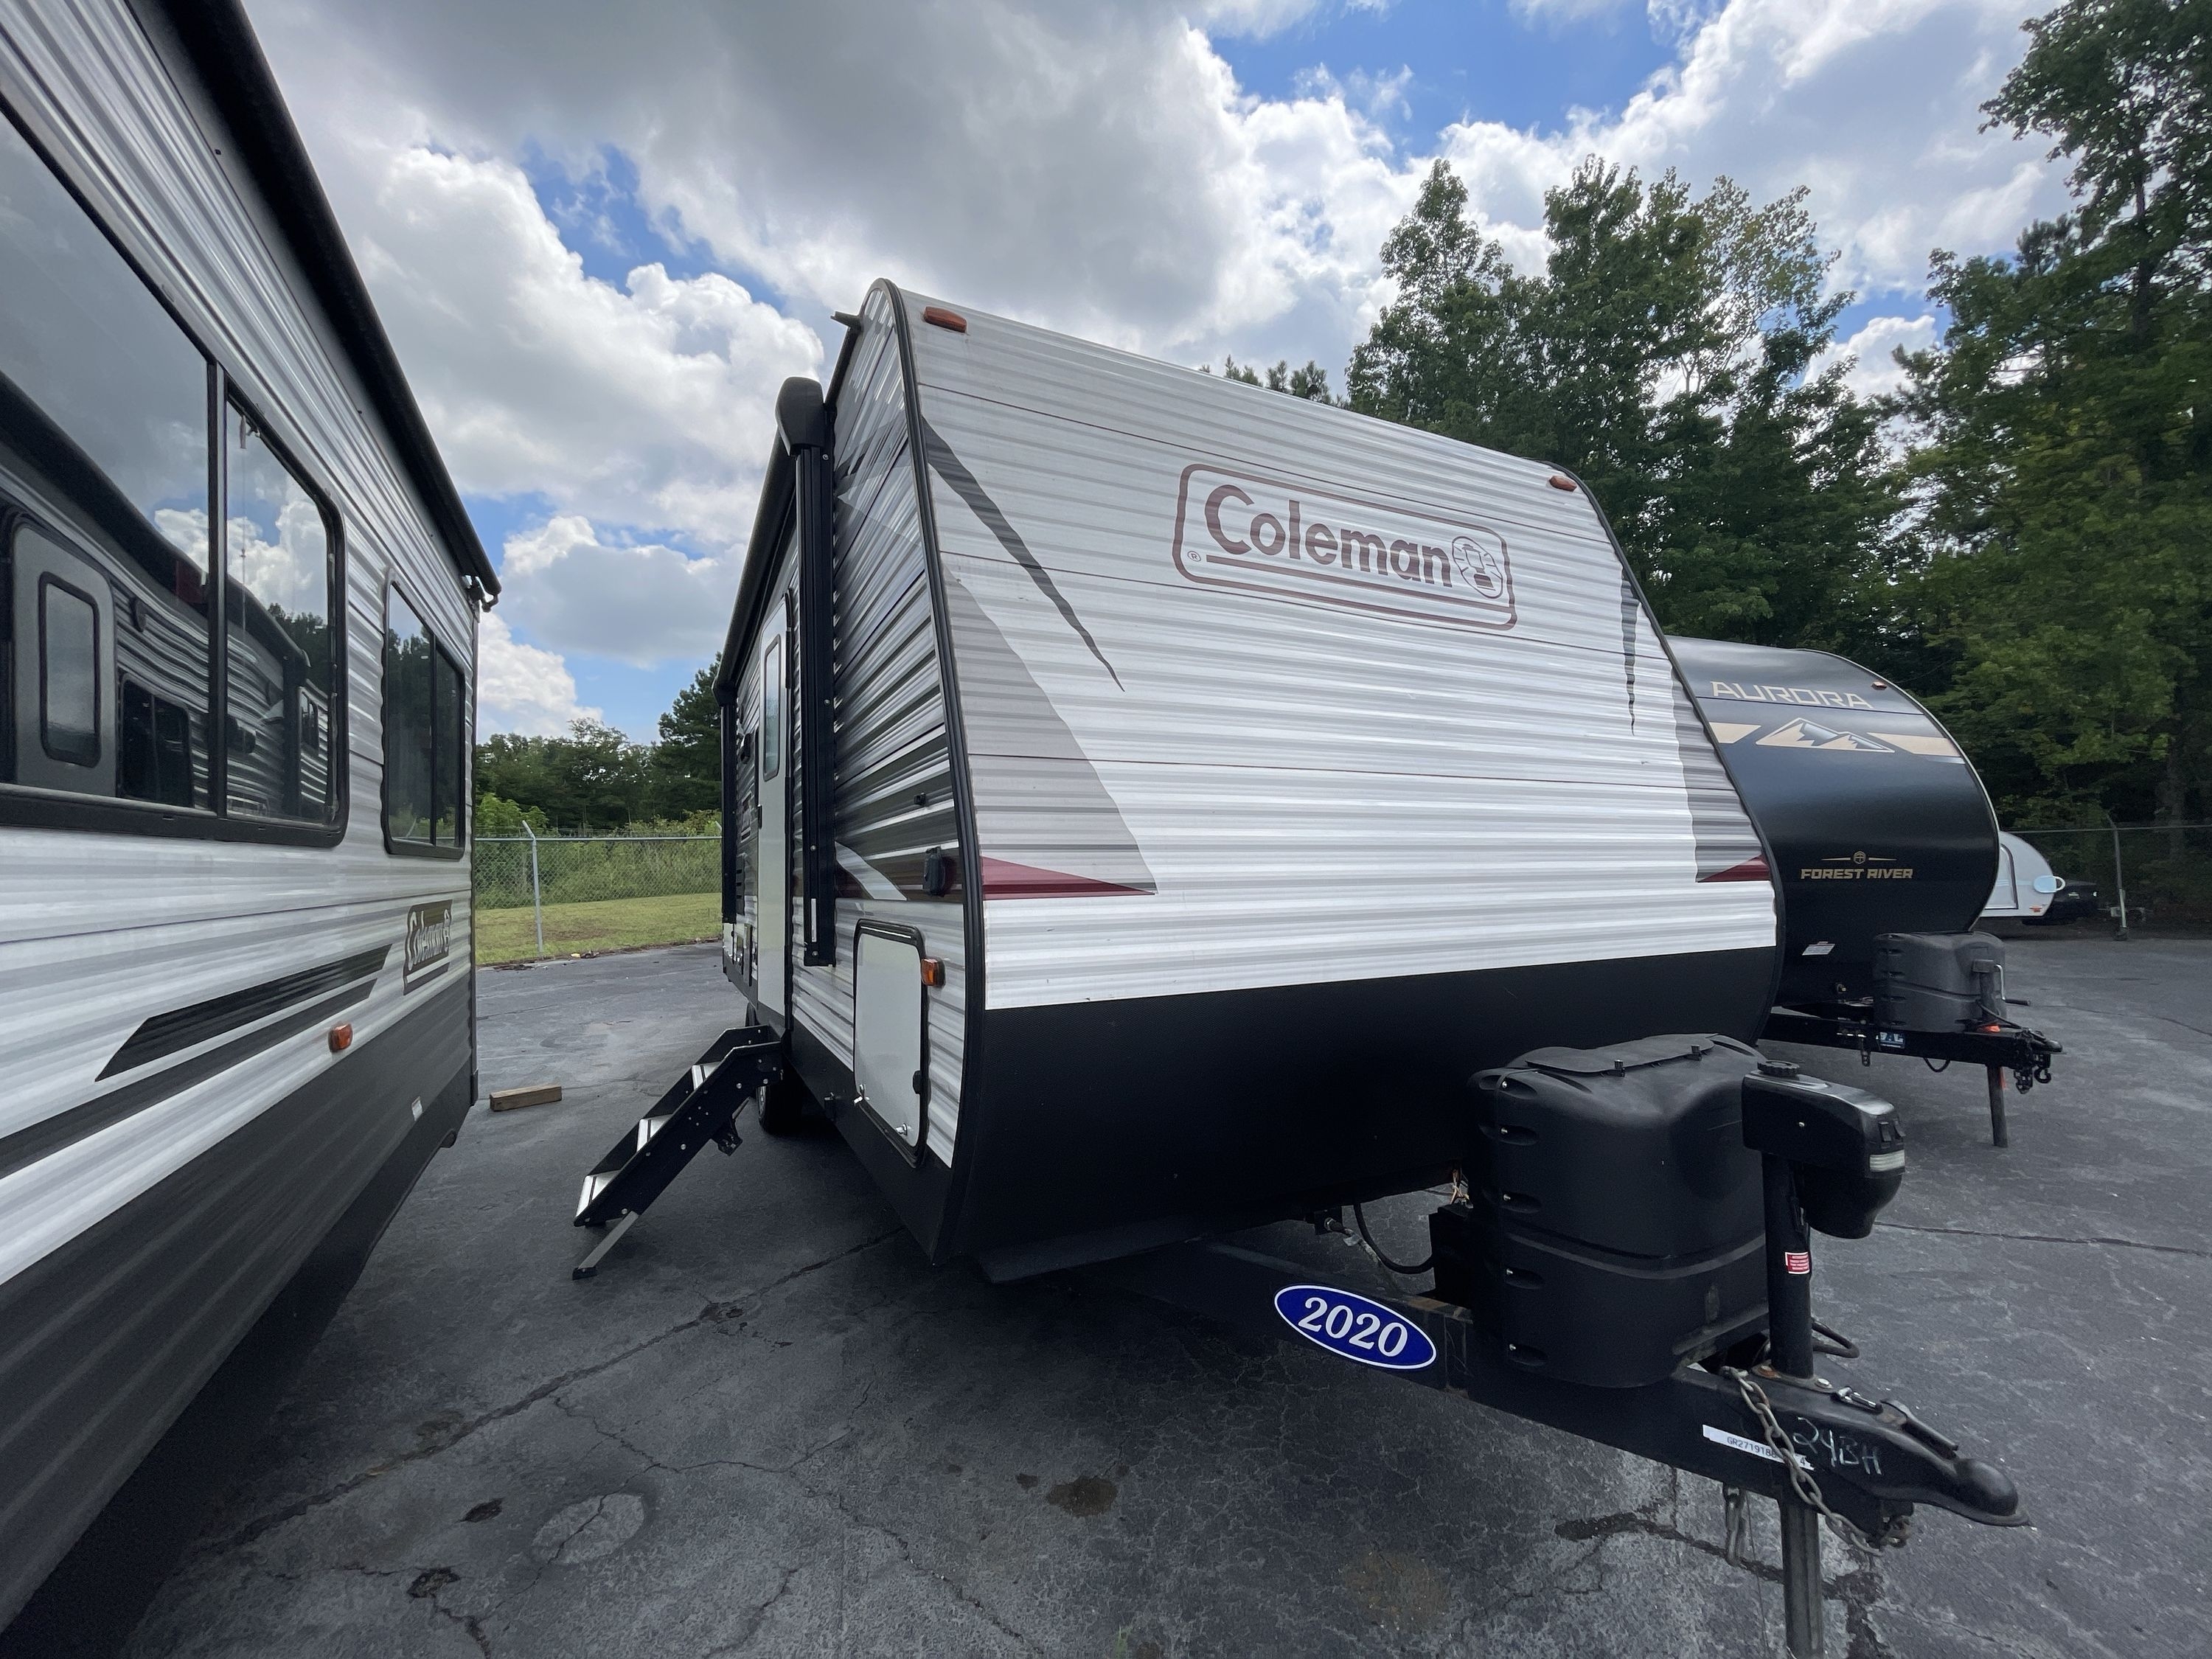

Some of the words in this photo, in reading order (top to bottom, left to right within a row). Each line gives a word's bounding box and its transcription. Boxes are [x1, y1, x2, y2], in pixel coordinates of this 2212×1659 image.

[1204, 484, 1453, 588] Coleman
[1710, 681, 1874, 709] AURORA
[1800, 868, 1865, 880] FOREST
[1866, 868, 1913, 879] RIVER
[1298, 1296, 1408, 1357] 2020
